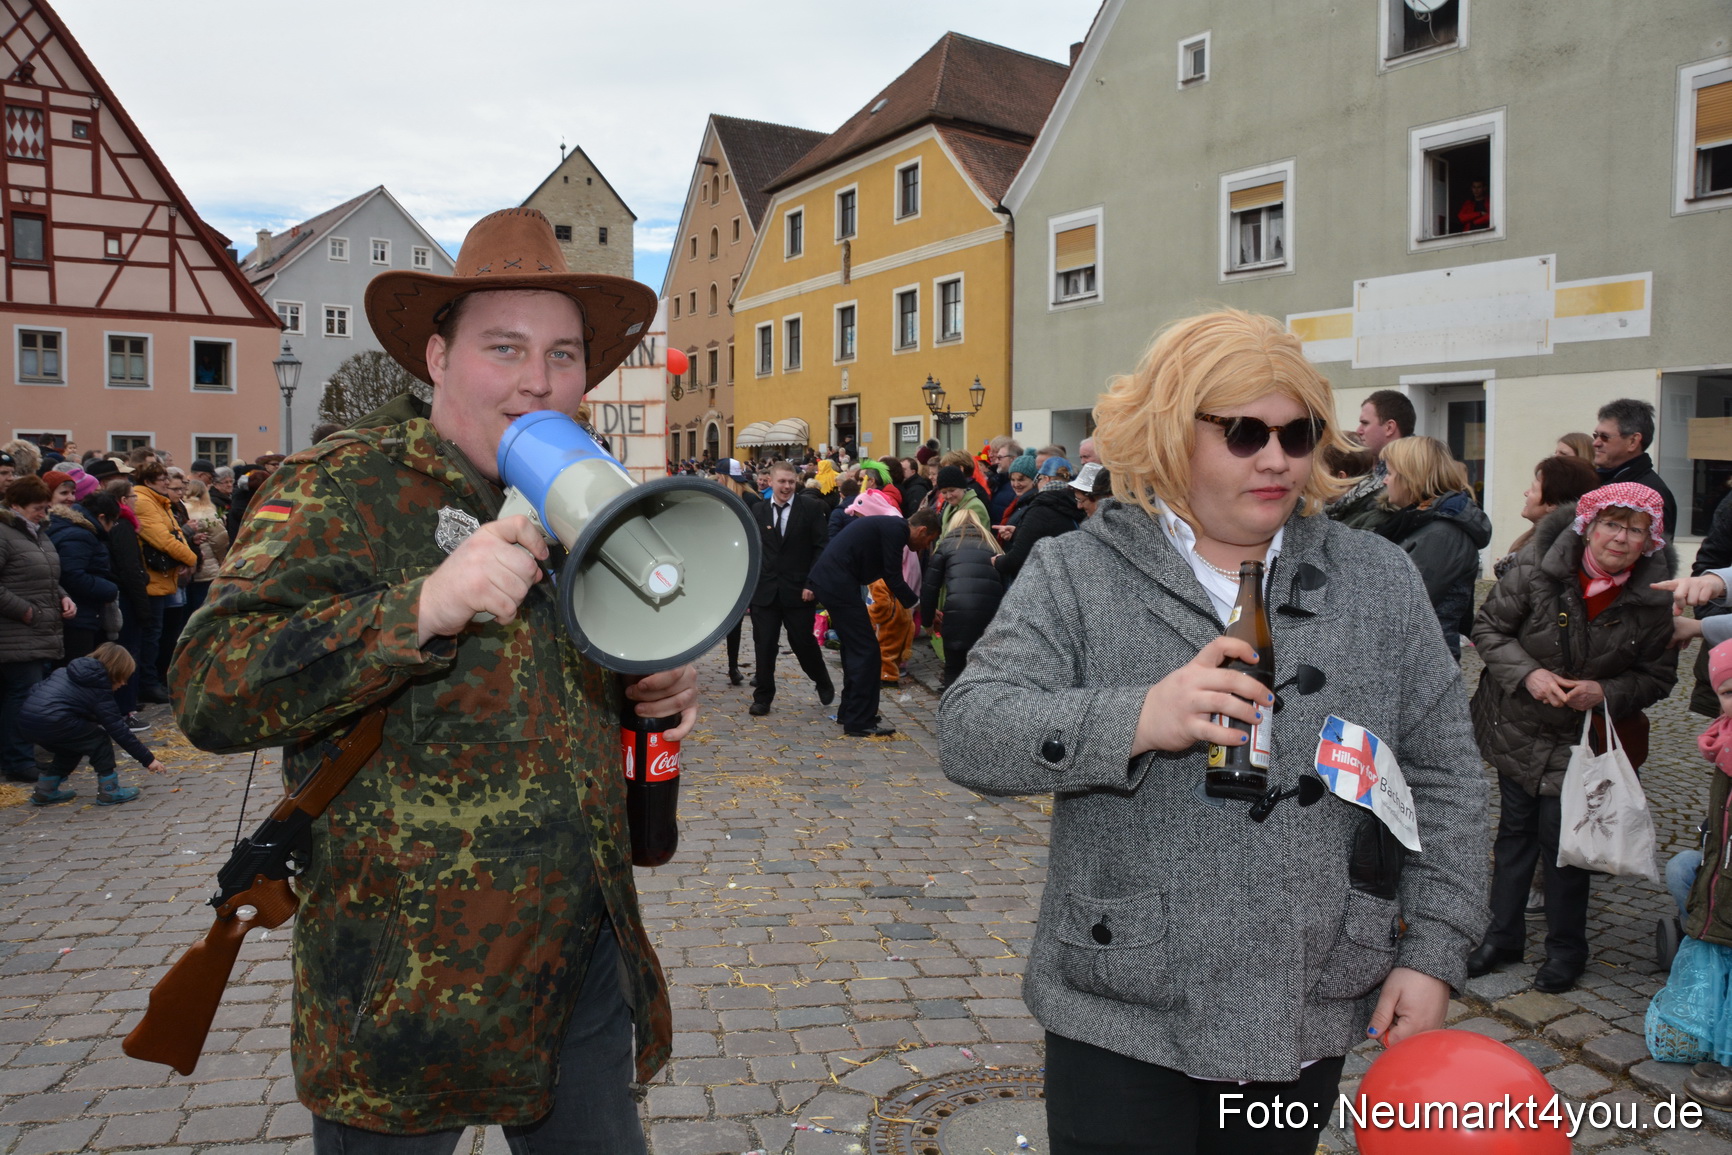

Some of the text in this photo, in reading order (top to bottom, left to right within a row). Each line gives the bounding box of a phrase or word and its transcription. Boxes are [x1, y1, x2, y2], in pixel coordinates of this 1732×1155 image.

[603, 403, 646, 434] DIE
[902, 426, 917, 435] BW
[1331, 748, 1378, 783] Hillary for
